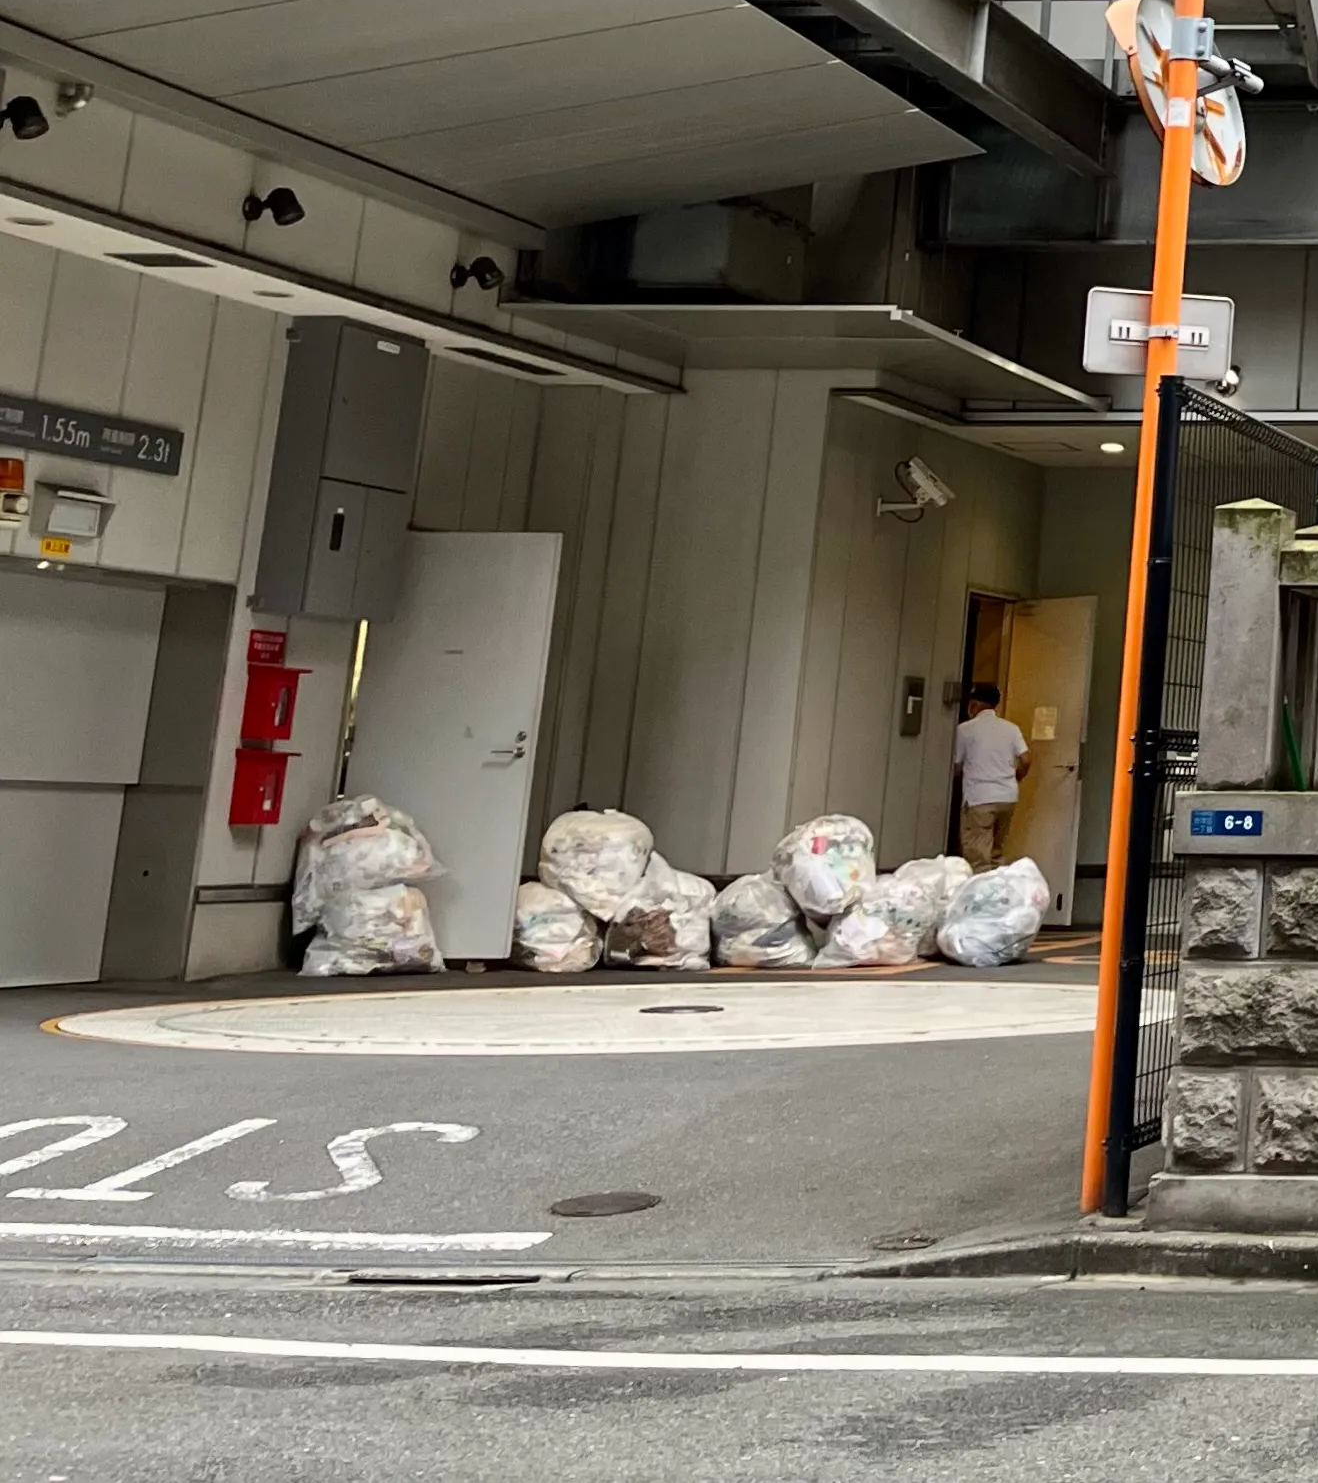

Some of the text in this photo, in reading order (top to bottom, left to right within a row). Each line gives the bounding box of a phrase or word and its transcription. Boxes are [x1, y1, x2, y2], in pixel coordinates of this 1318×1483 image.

[41, 414, 91, 448] 1.55m
[137, 435, 171, 464] 2.3t
[1224, 814, 1254, 830] 6-8
